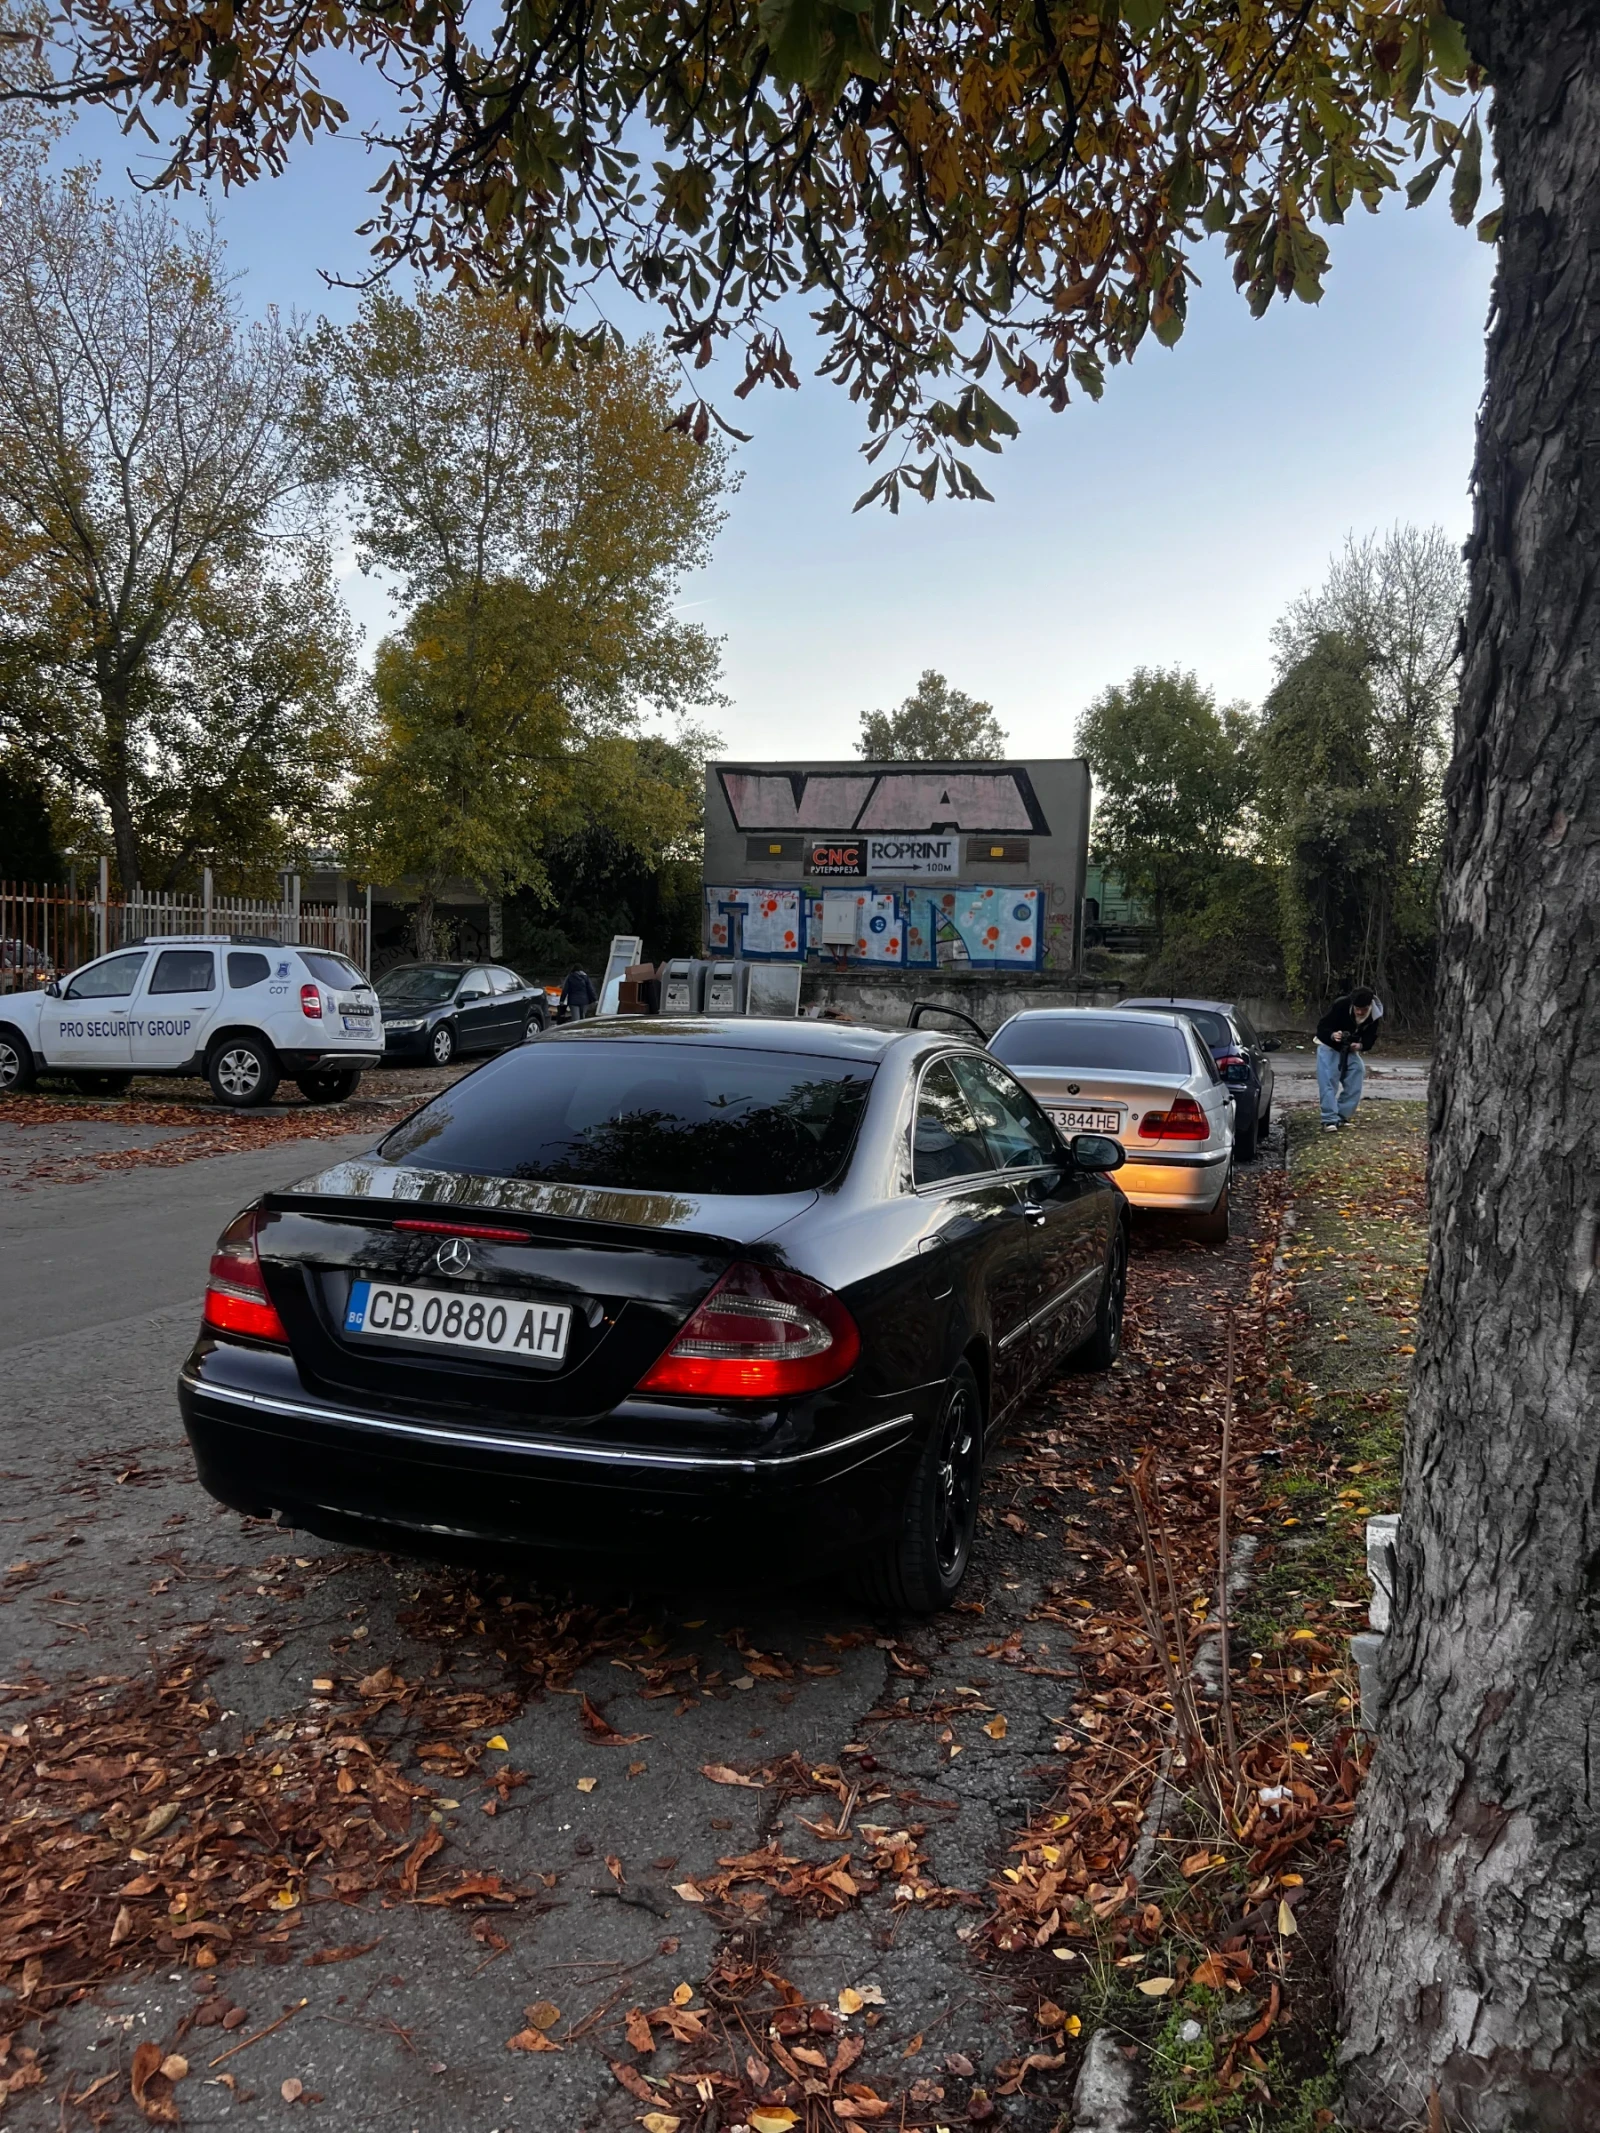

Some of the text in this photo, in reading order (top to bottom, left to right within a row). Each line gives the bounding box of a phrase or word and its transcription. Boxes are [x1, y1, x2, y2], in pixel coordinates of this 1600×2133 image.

[812, 848, 859, 866] CNC
[871, 841, 952, 859] ROPRINT
[810, 865, 860, 874] РУТЕРФРЕЗА
[60, 1020, 191, 1038] PRO SECURITY GROUP
[348, 1311, 363, 1323] BG
